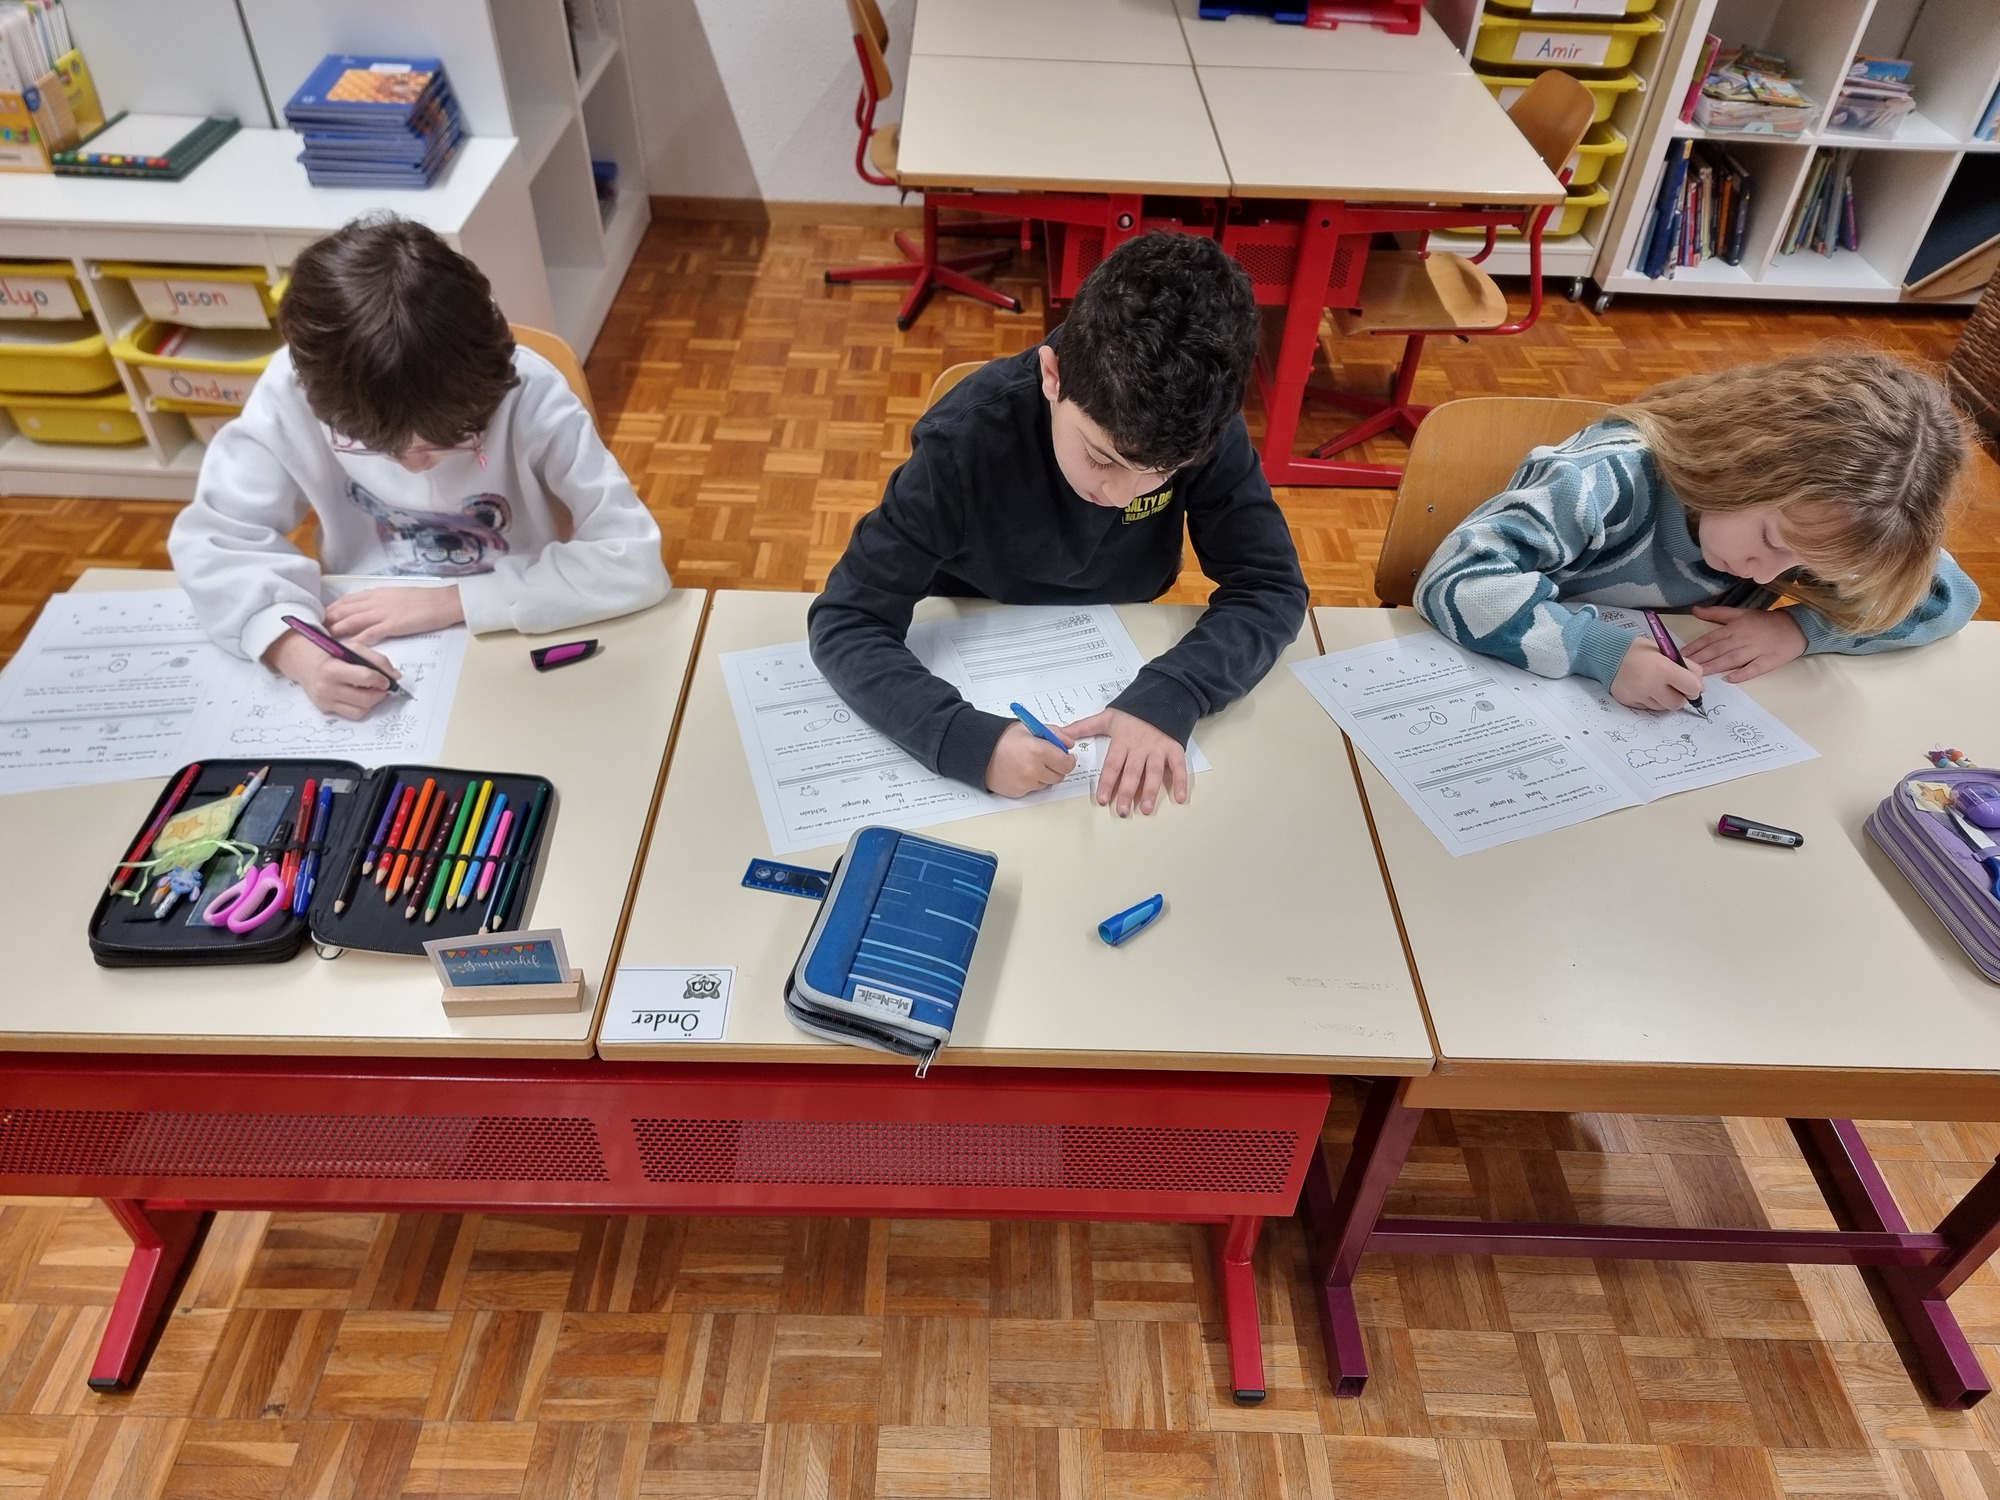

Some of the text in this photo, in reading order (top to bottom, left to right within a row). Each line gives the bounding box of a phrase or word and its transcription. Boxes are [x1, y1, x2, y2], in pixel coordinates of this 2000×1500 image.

[1536, 37, 1583, 59] Amir
[163, 280, 228, 315] Jason
[169, 369, 243, 401] Önder
[841, 799, 871, 808] Wampir
[885, 792, 903, 800] hund
[1453, 790, 1543, 817] hund Wampir Schlein
[799, 807, 827, 816] Schlein
[631, 1013, 699, 1037] Önder
